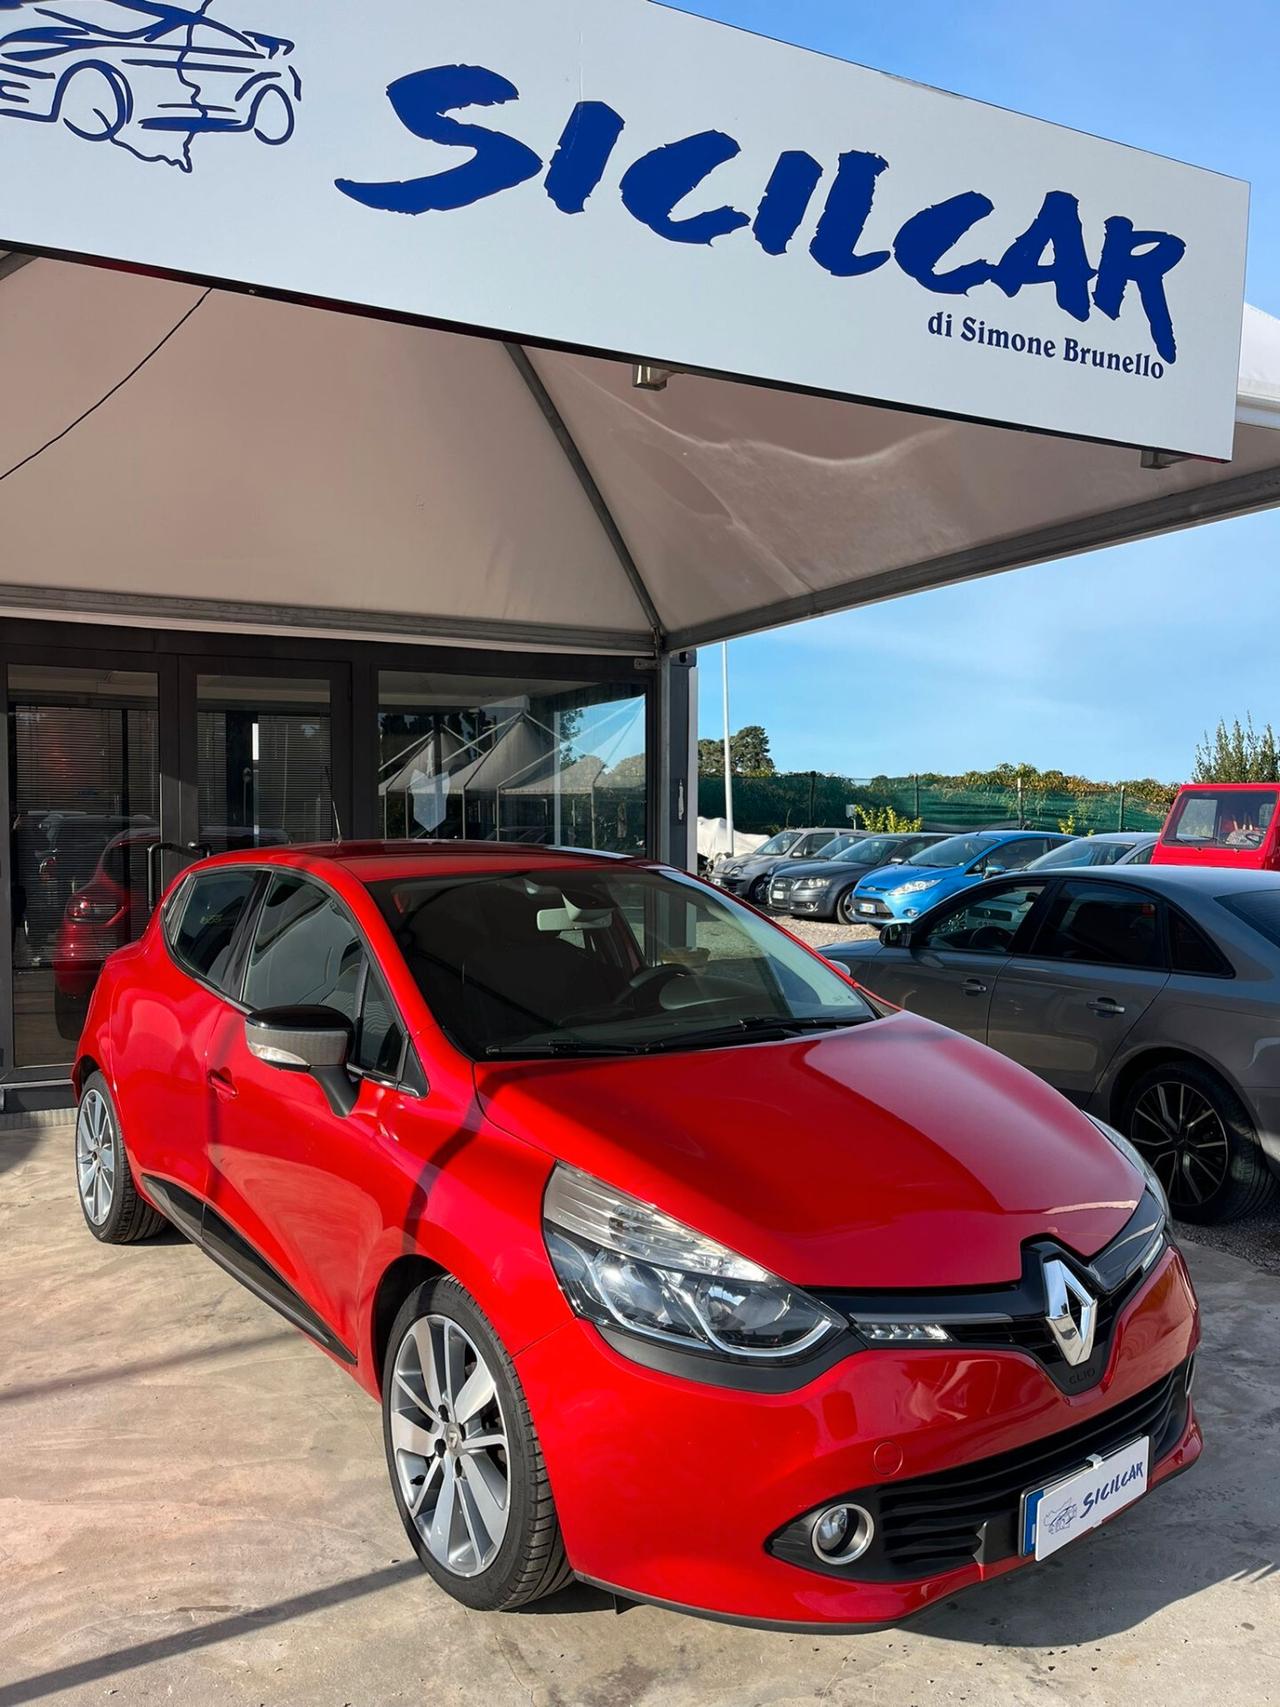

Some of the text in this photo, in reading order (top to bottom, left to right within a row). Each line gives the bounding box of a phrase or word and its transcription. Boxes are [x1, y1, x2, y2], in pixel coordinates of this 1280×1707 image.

[335, 64, 1186, 364] SICILCAR
[928, 311, 1164, 379] di Simone Brunello
[1069, 1367, 1096, 1385] CLIO
[1079, 1461, 1144, 1519] SICILCAR
